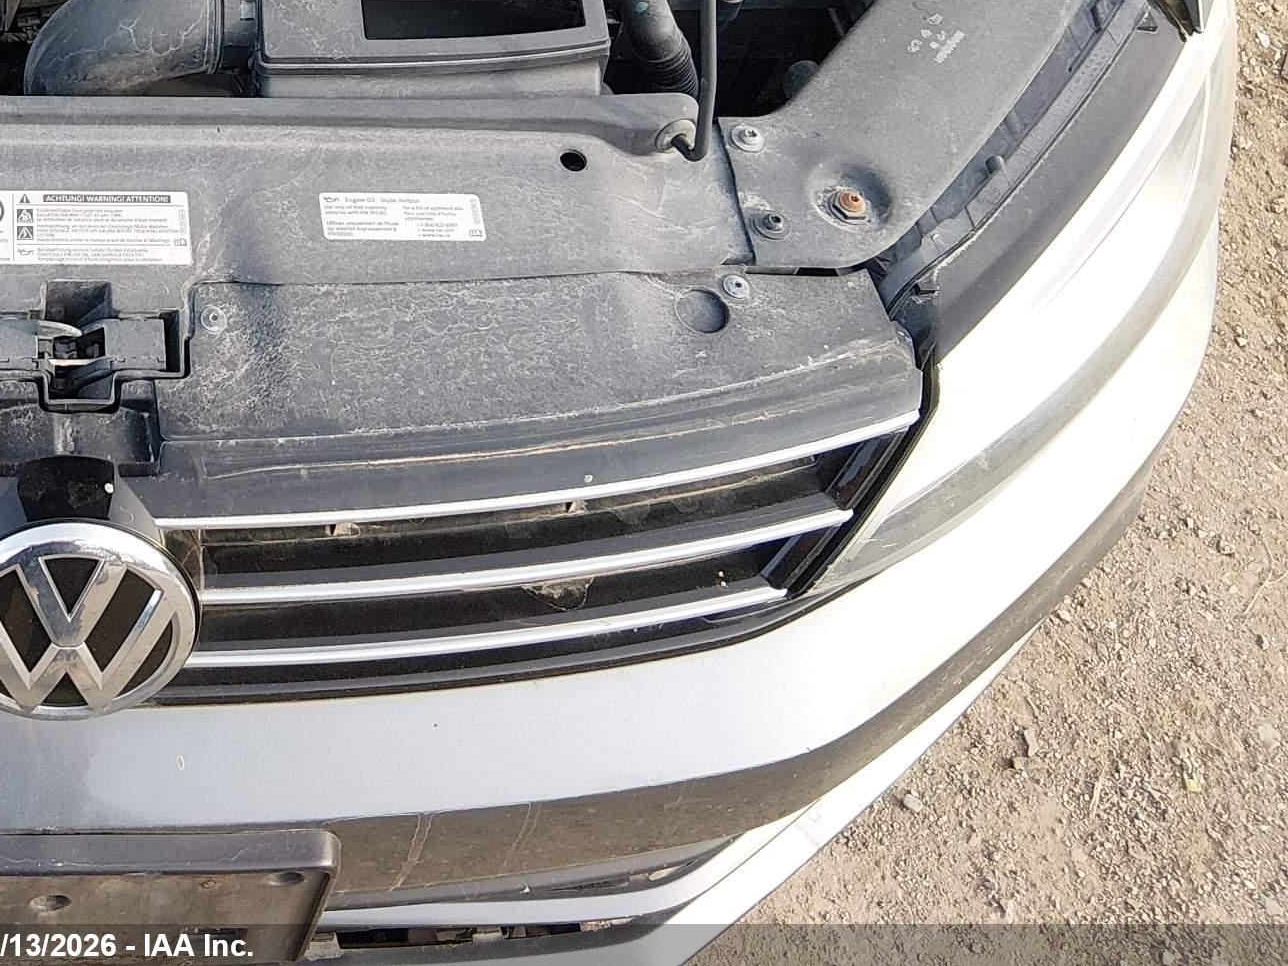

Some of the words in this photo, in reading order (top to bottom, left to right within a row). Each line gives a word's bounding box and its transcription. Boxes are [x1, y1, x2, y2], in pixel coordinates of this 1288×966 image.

[46, 194, 85, 203] ACHTUNG!
[86, 194, 125, 203] WARNING!
[126, 194, 169, 203] ATTENTION!
